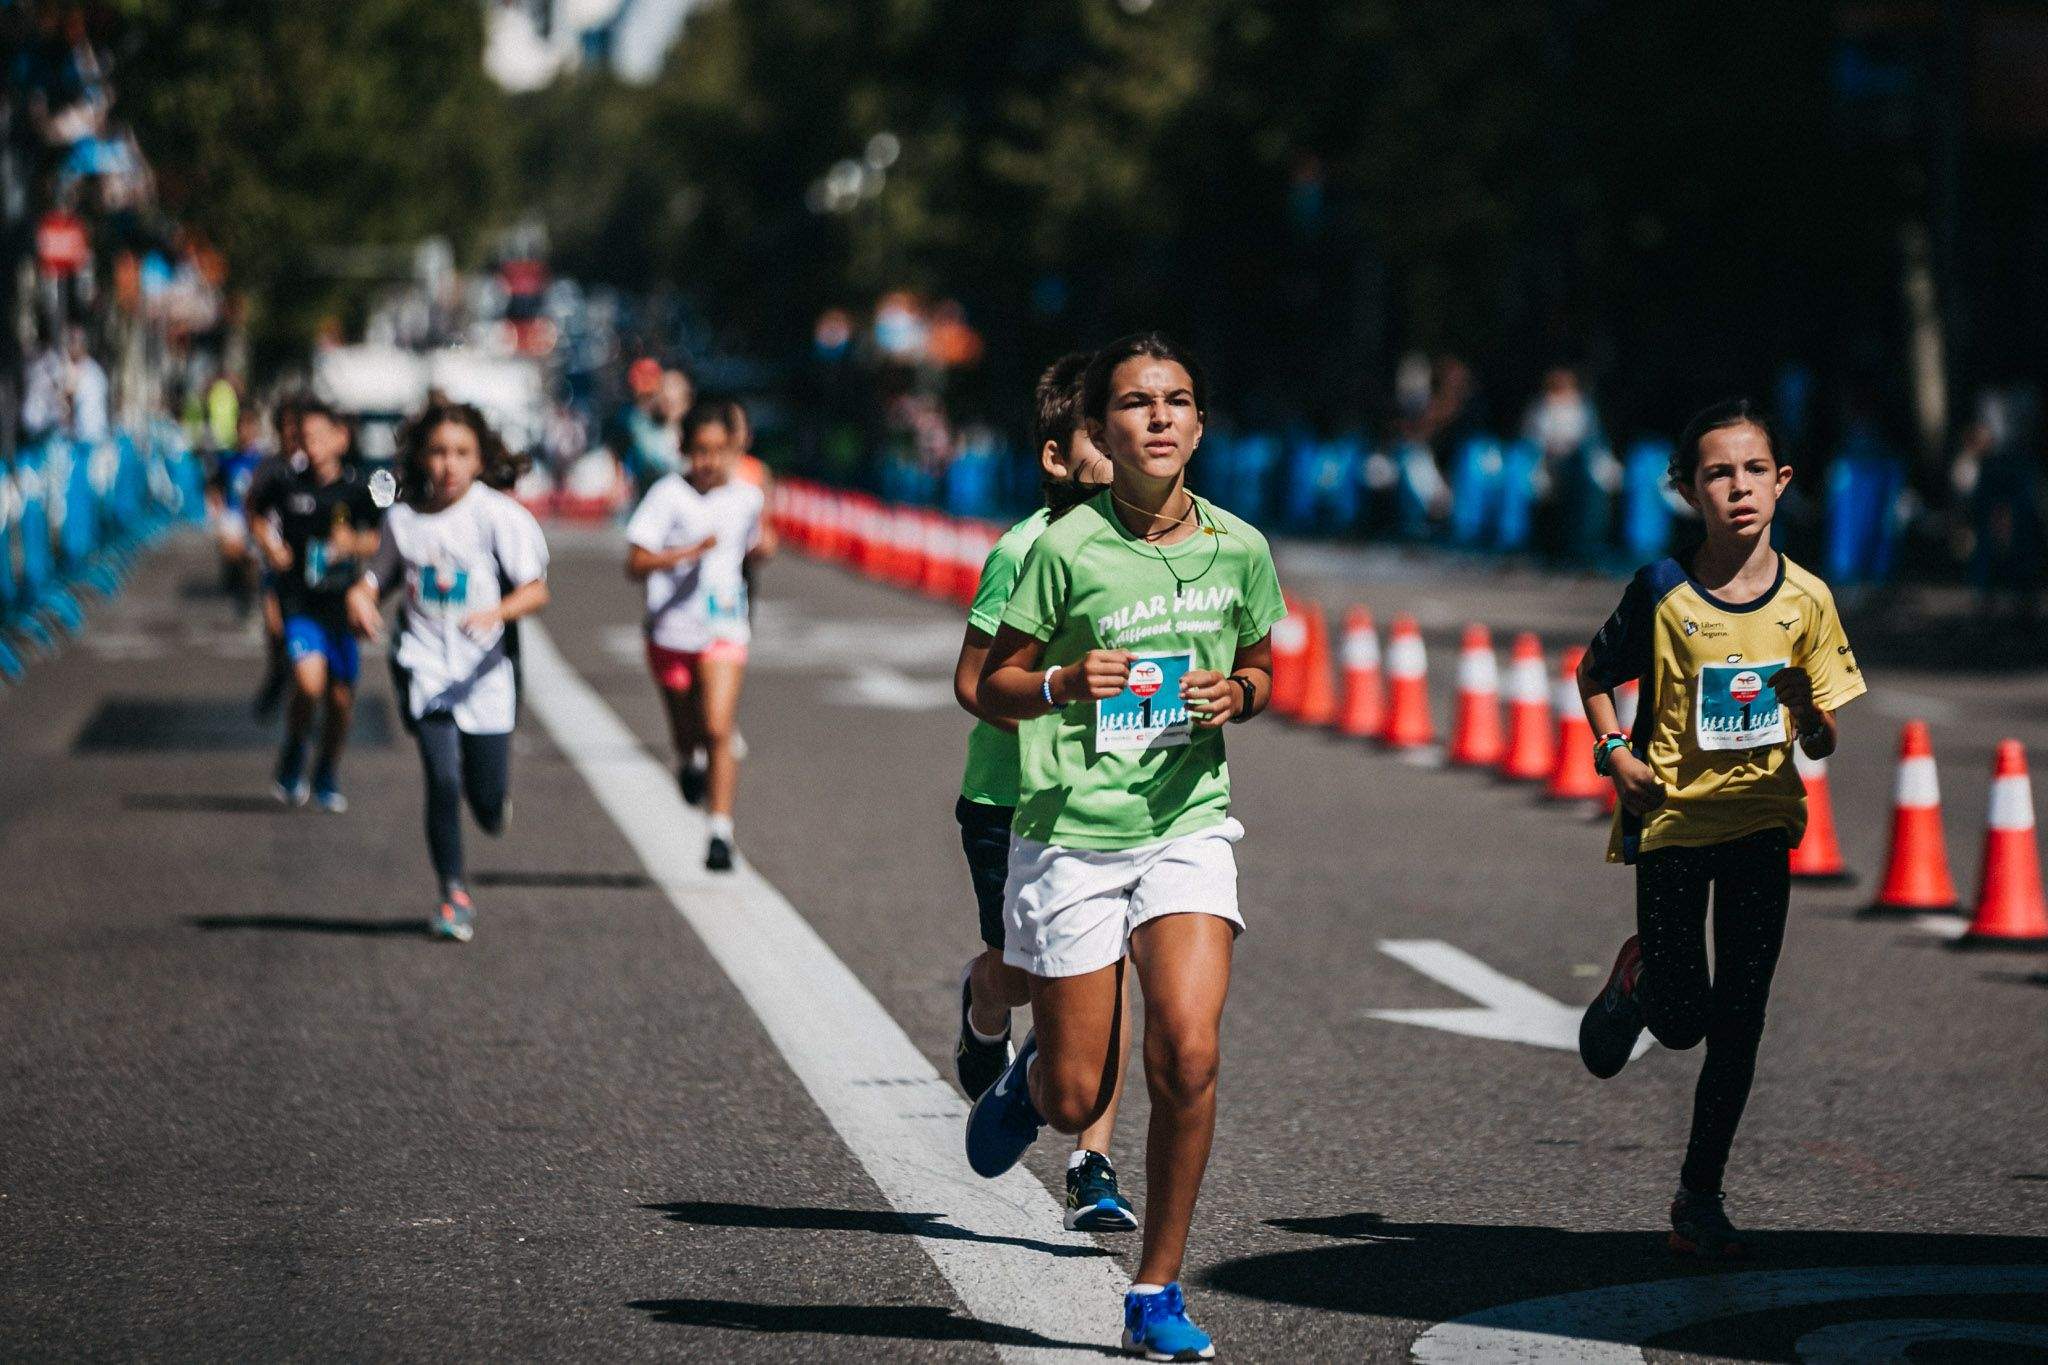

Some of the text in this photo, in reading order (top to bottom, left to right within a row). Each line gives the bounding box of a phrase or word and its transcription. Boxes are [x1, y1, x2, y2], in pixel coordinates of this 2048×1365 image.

[1097, 595, 1168, 636] PILAR
[1138, 697, 1152, 728] 1
[1739, 702, 1752, 731] 1
